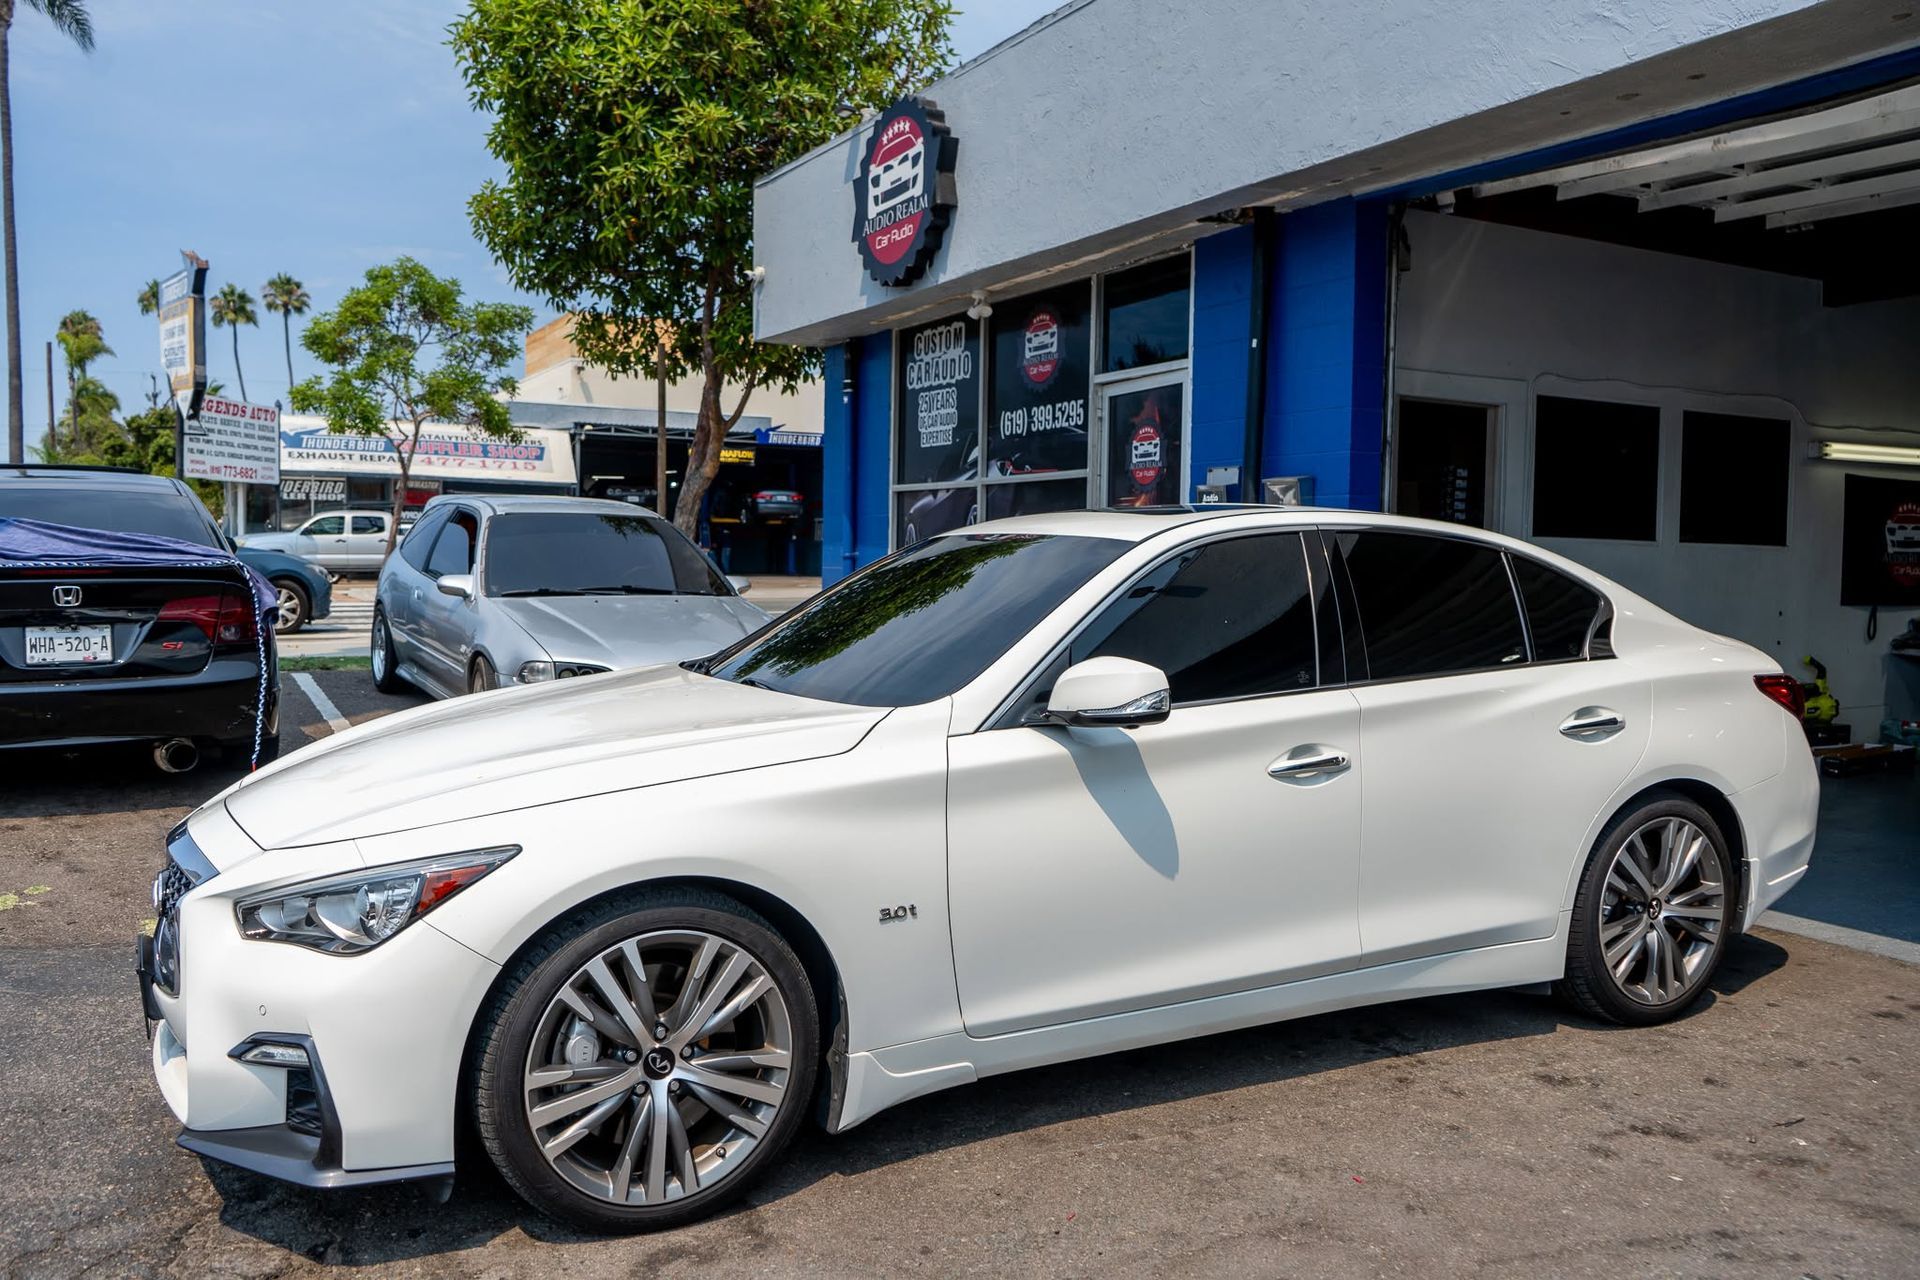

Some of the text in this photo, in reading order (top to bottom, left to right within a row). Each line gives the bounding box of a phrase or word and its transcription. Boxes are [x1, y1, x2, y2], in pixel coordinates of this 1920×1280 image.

[862, 193, 929, 237] AUDIO REALM
[875, 223, 914, 250] Car Audio
[914, 321, 966, 361] CUSTOM
[930, 387, 957, 412] YEARS
[249, 407, 276, 423] AUTO
[1000, 399, 1085, 440] (619) 399.5295
[301, 436, 386, 451] THUNDERBIRD
[768, 432, 821, 446] THUNDERBIRD
[921, 428, 953, 448] EXPERTISE
[287, 450, 355, 460] EXHAUST
[488, 444, 541, 459] SHOP
[420, 456, 537, 471] 477-1715
[29, 634, 109, 654] WHA-520-A
